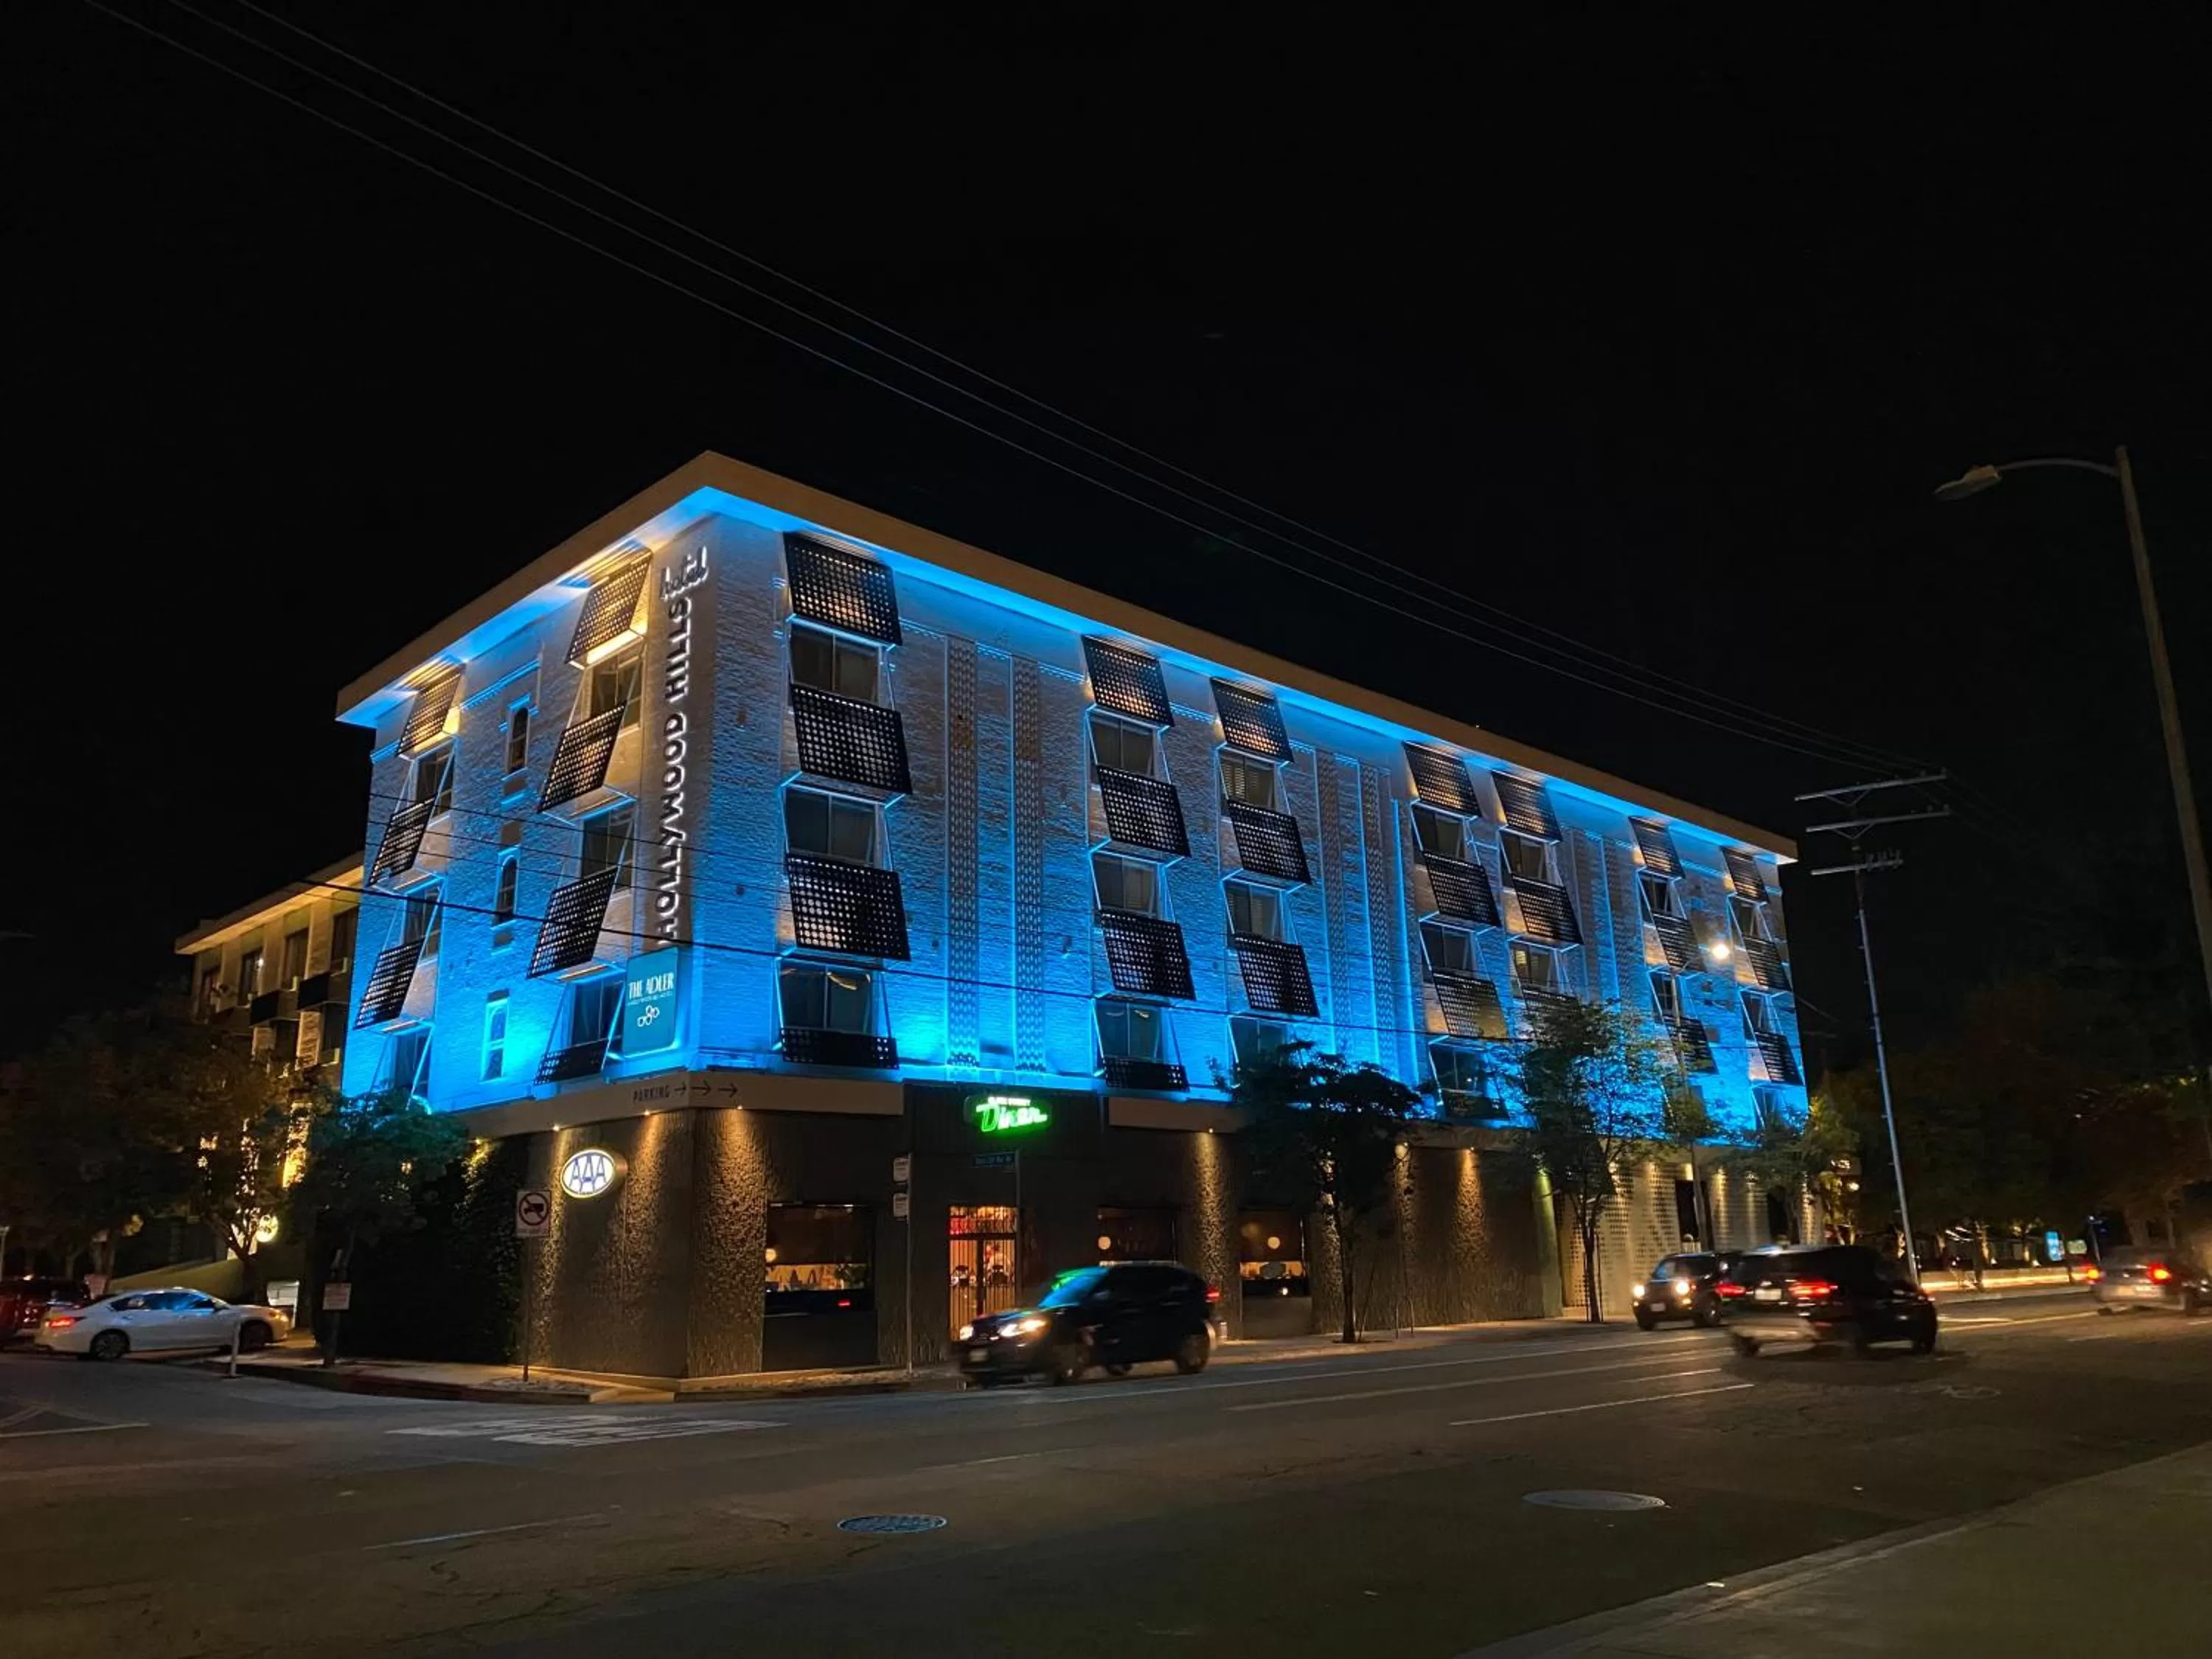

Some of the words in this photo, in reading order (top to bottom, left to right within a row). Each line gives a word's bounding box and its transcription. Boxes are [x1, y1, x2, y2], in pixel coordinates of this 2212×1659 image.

[665, 597, 692, 703] HILLS
[655, 711, 687, 945] HOLLYWOOD
[629, 980, 644, 1000] THE
[646, 972, 675, 995] ADLER
[633, 1085, 670, 1102] PARKING
[568, 1153, 607, 1192] AAA
